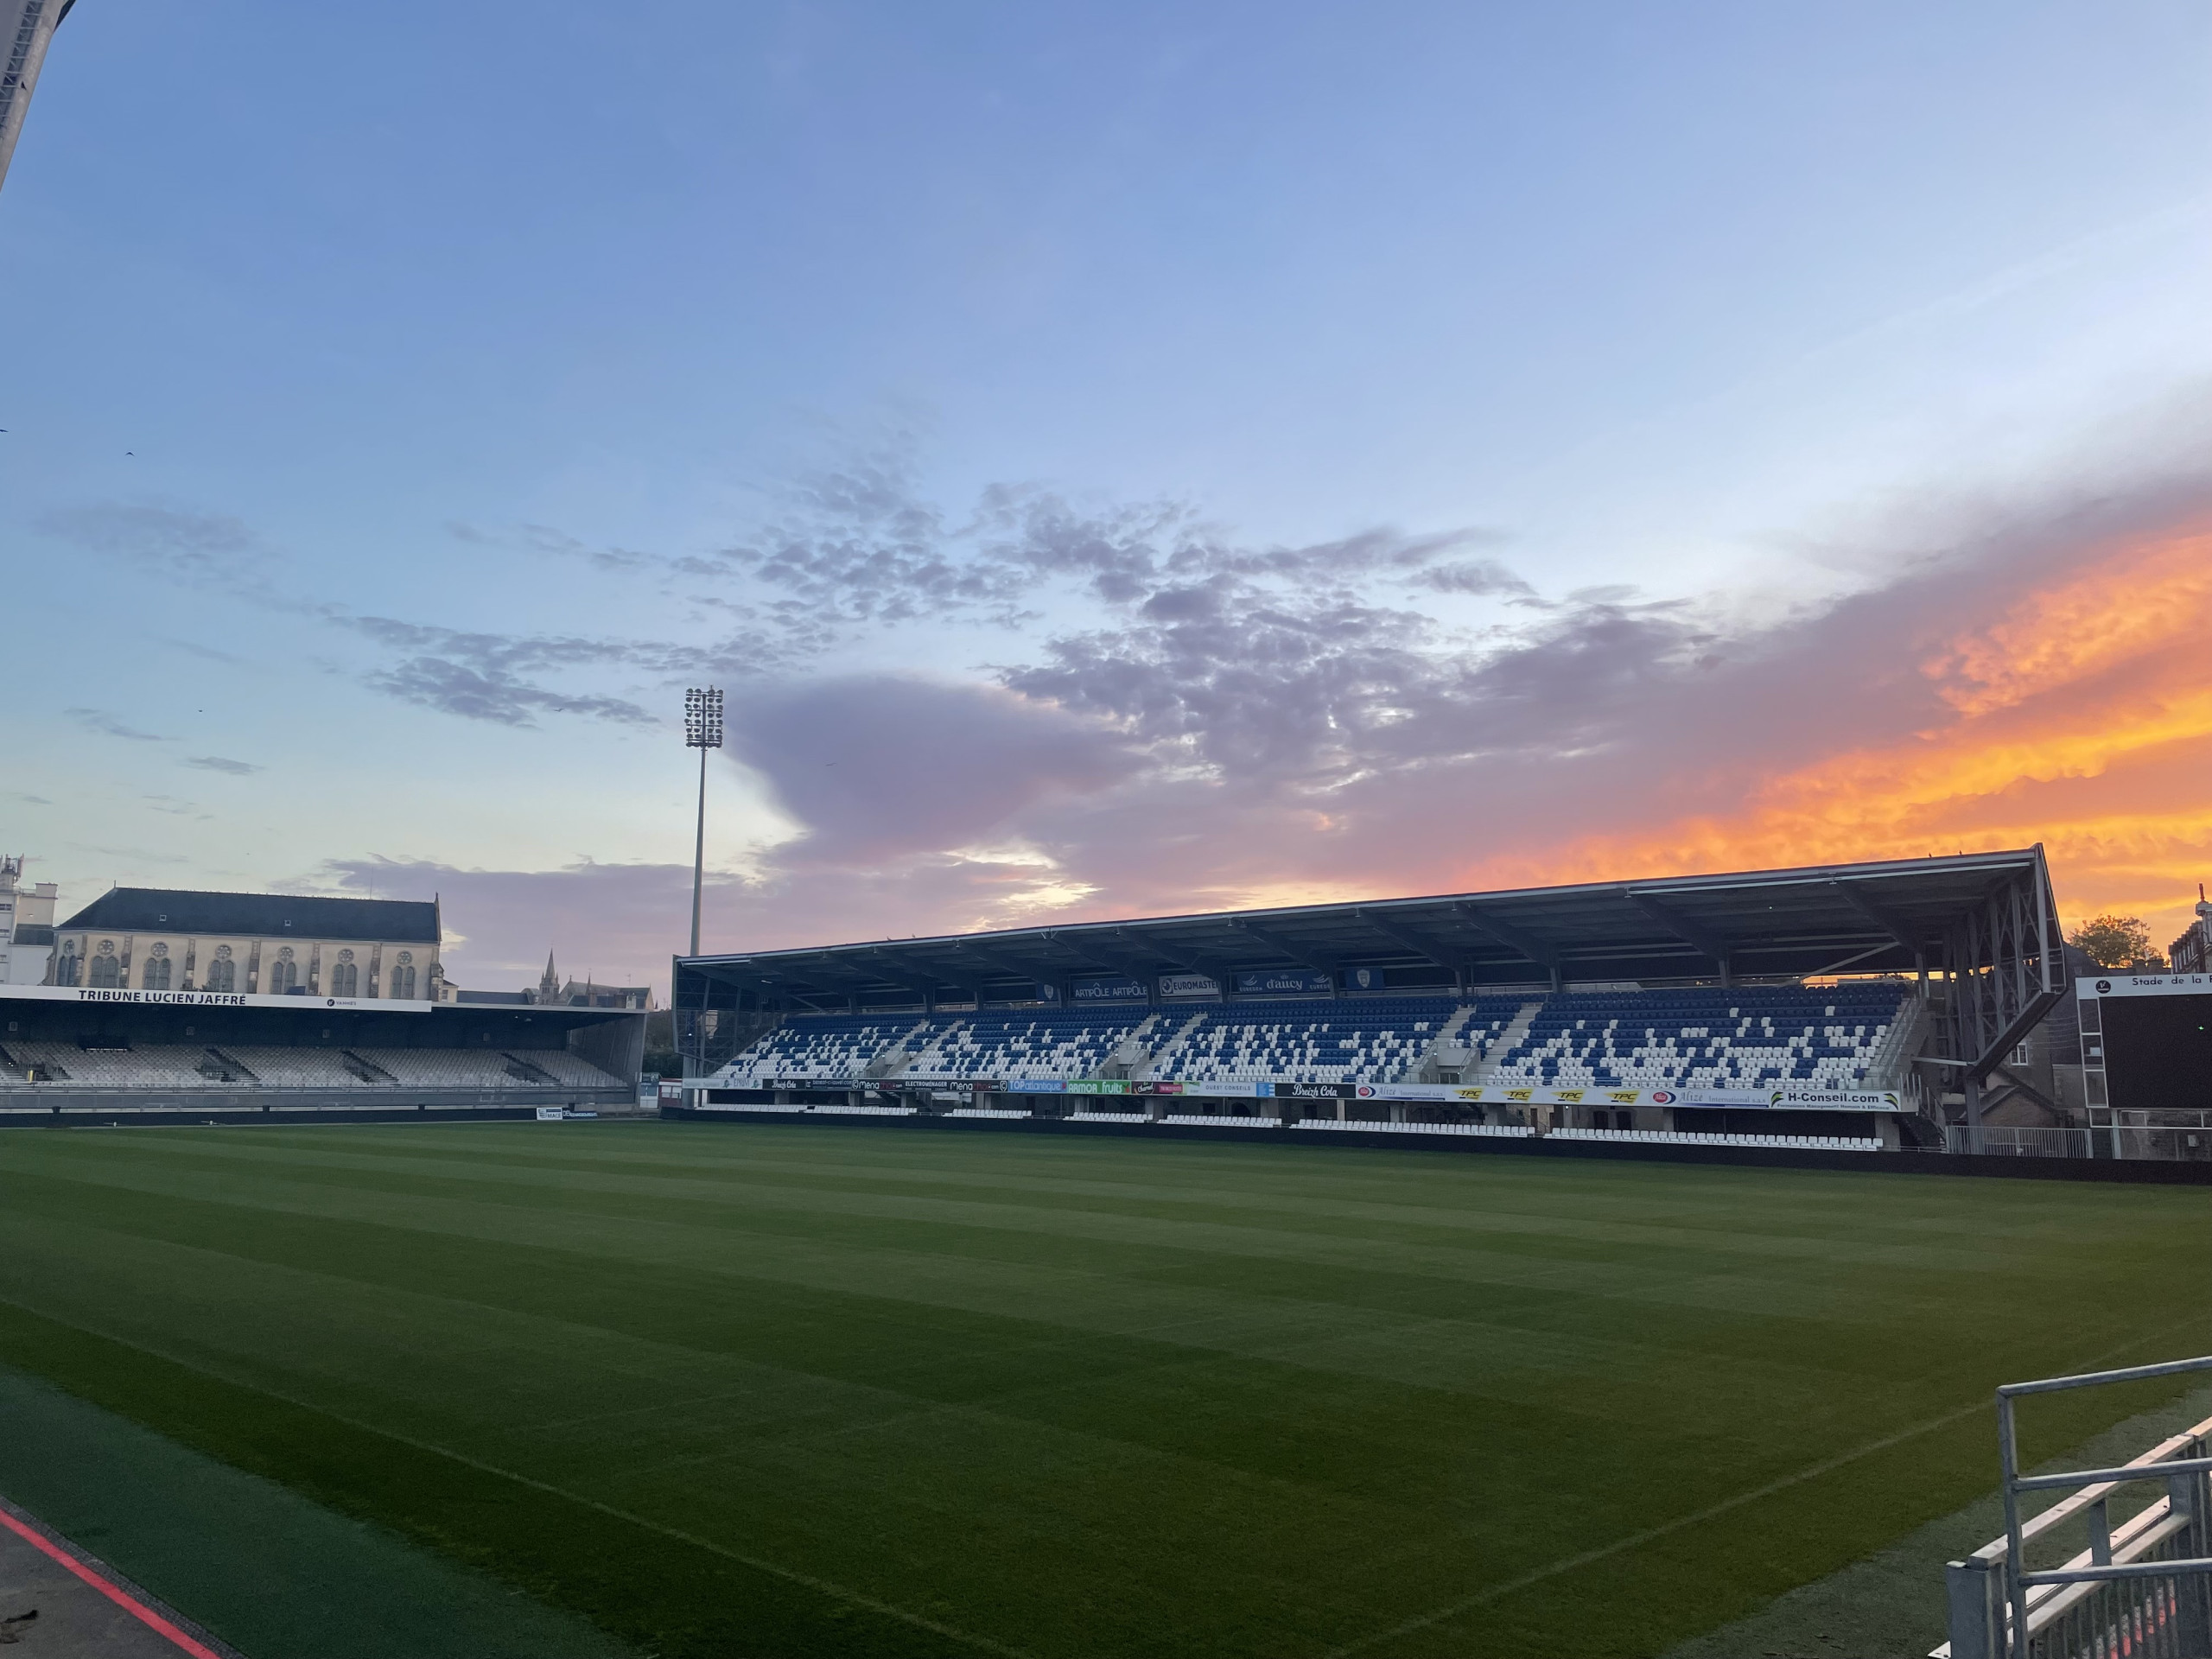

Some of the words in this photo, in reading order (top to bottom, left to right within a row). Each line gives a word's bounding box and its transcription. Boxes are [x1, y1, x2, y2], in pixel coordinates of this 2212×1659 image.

[1173, 980, 1218, 990] EUROMASTE
[1266, 978, 1303, 990] d'aucy
[2132, 976, 2163, 986] Stade
[2171, 976, 2184, 984] de
[2192, 975, 2202, 983] la
[1075, 982, 1109, 997] ARTIPÔLE
[1112, 981, 1147, 996] ARTIPÔLE
[79, 989, 140, 1001] TRIBUNE
[145, 993, 194, 1003] LUCIEN
[198, 994, 246, 1005] JAFFRÉ
[1292, 1084, 1319, 1097] Breizh
[1320, 1085, 1338, 1096] Cola
[1788, 1092, 1879, 1103] H-Conseil.com
